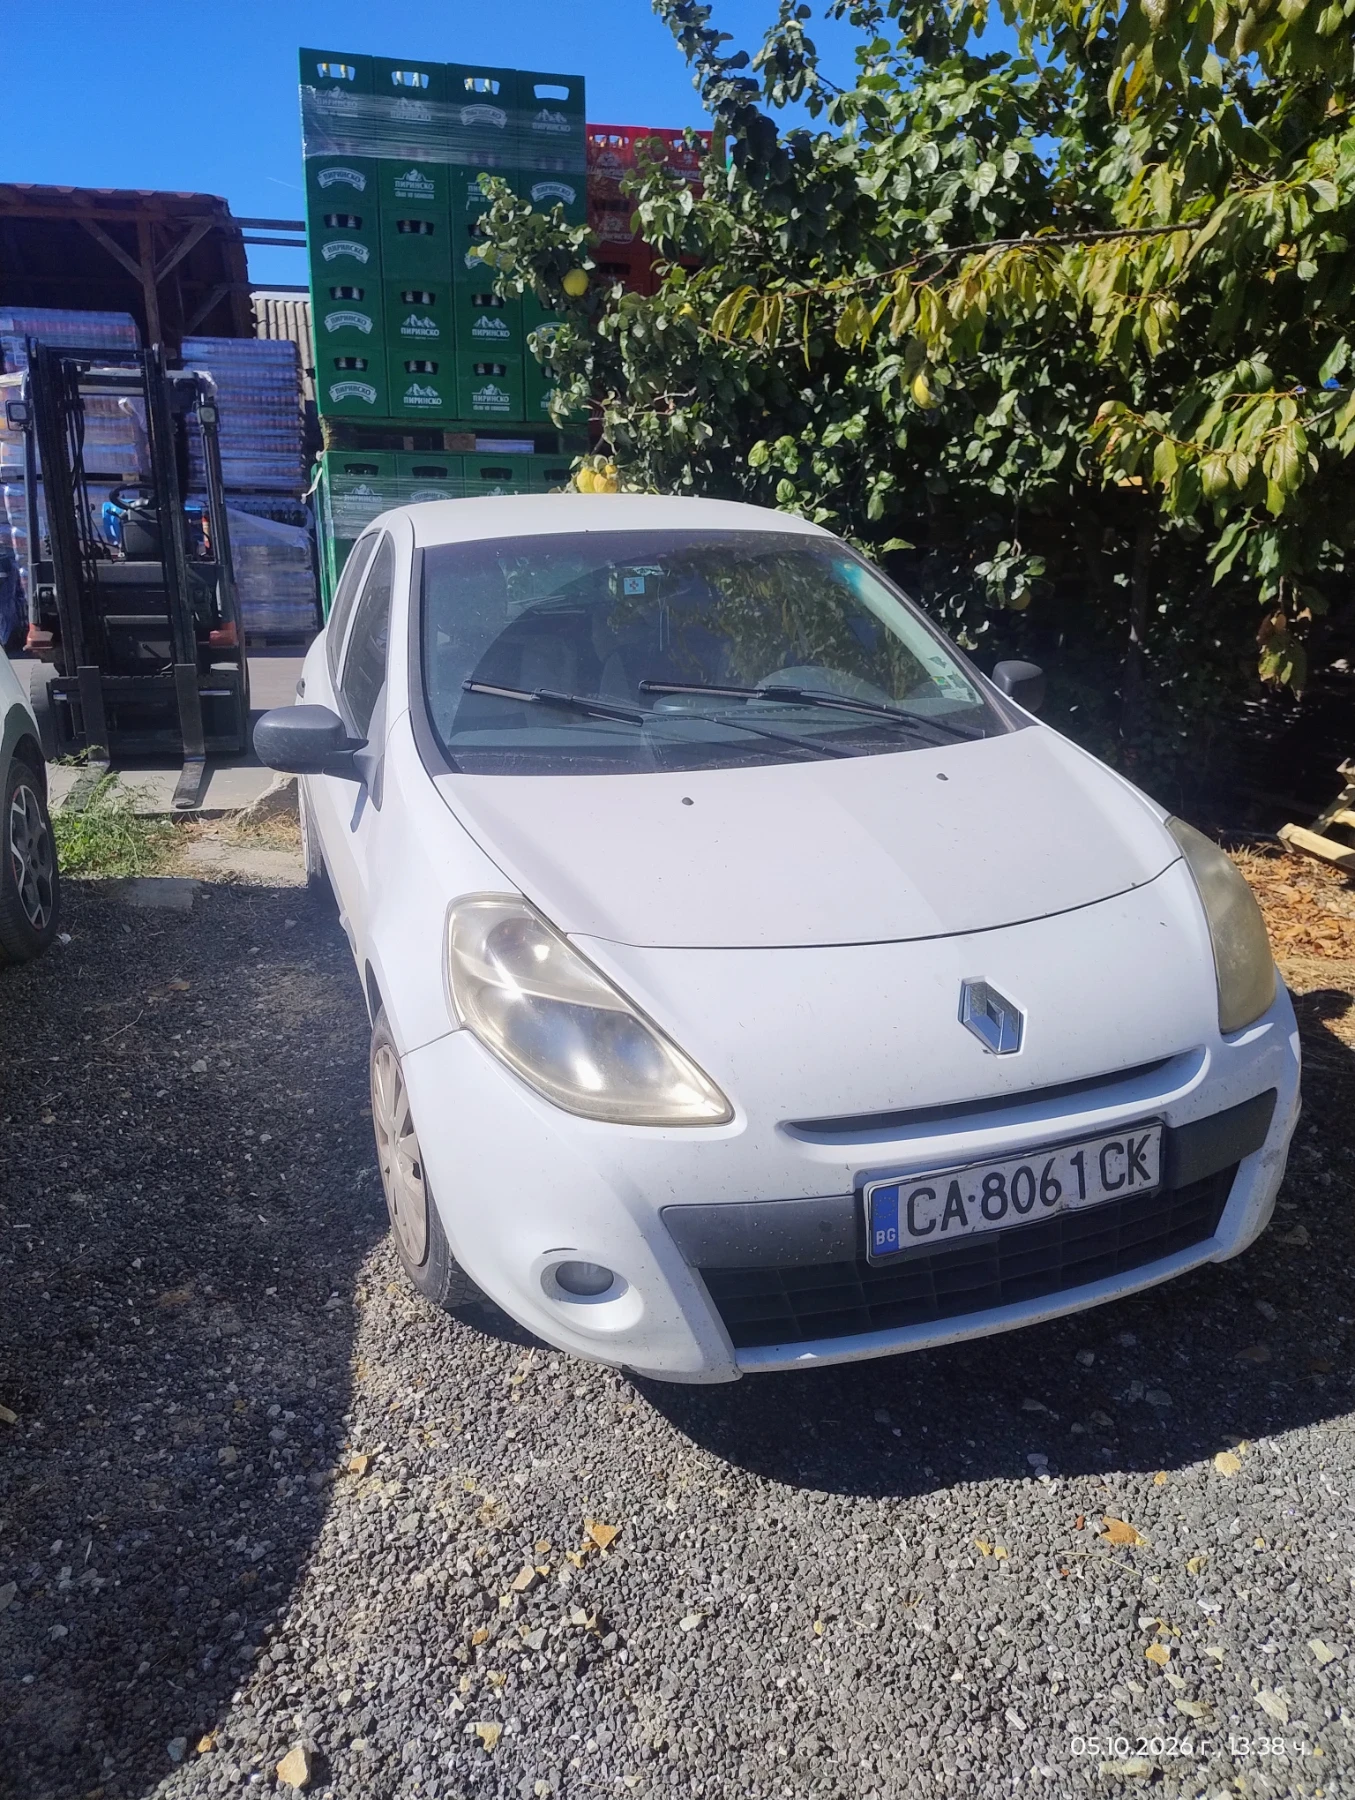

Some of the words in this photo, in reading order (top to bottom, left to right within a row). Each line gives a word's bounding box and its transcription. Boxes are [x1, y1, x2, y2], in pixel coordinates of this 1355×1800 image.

[394, 180, 435, 190] ПИРИНСКО
[400, 327, 440, 336] ПИРИНСКО
[472, 328, 510, 337] ПИРИНСКО
[403, 396, 442, 405] ПИРИНСКО
[472, 394, 510, 403] ПИРИНСКО
[980, 1150, 1087, 1221] 8061
[875, 1227, 897, 1247] BG
